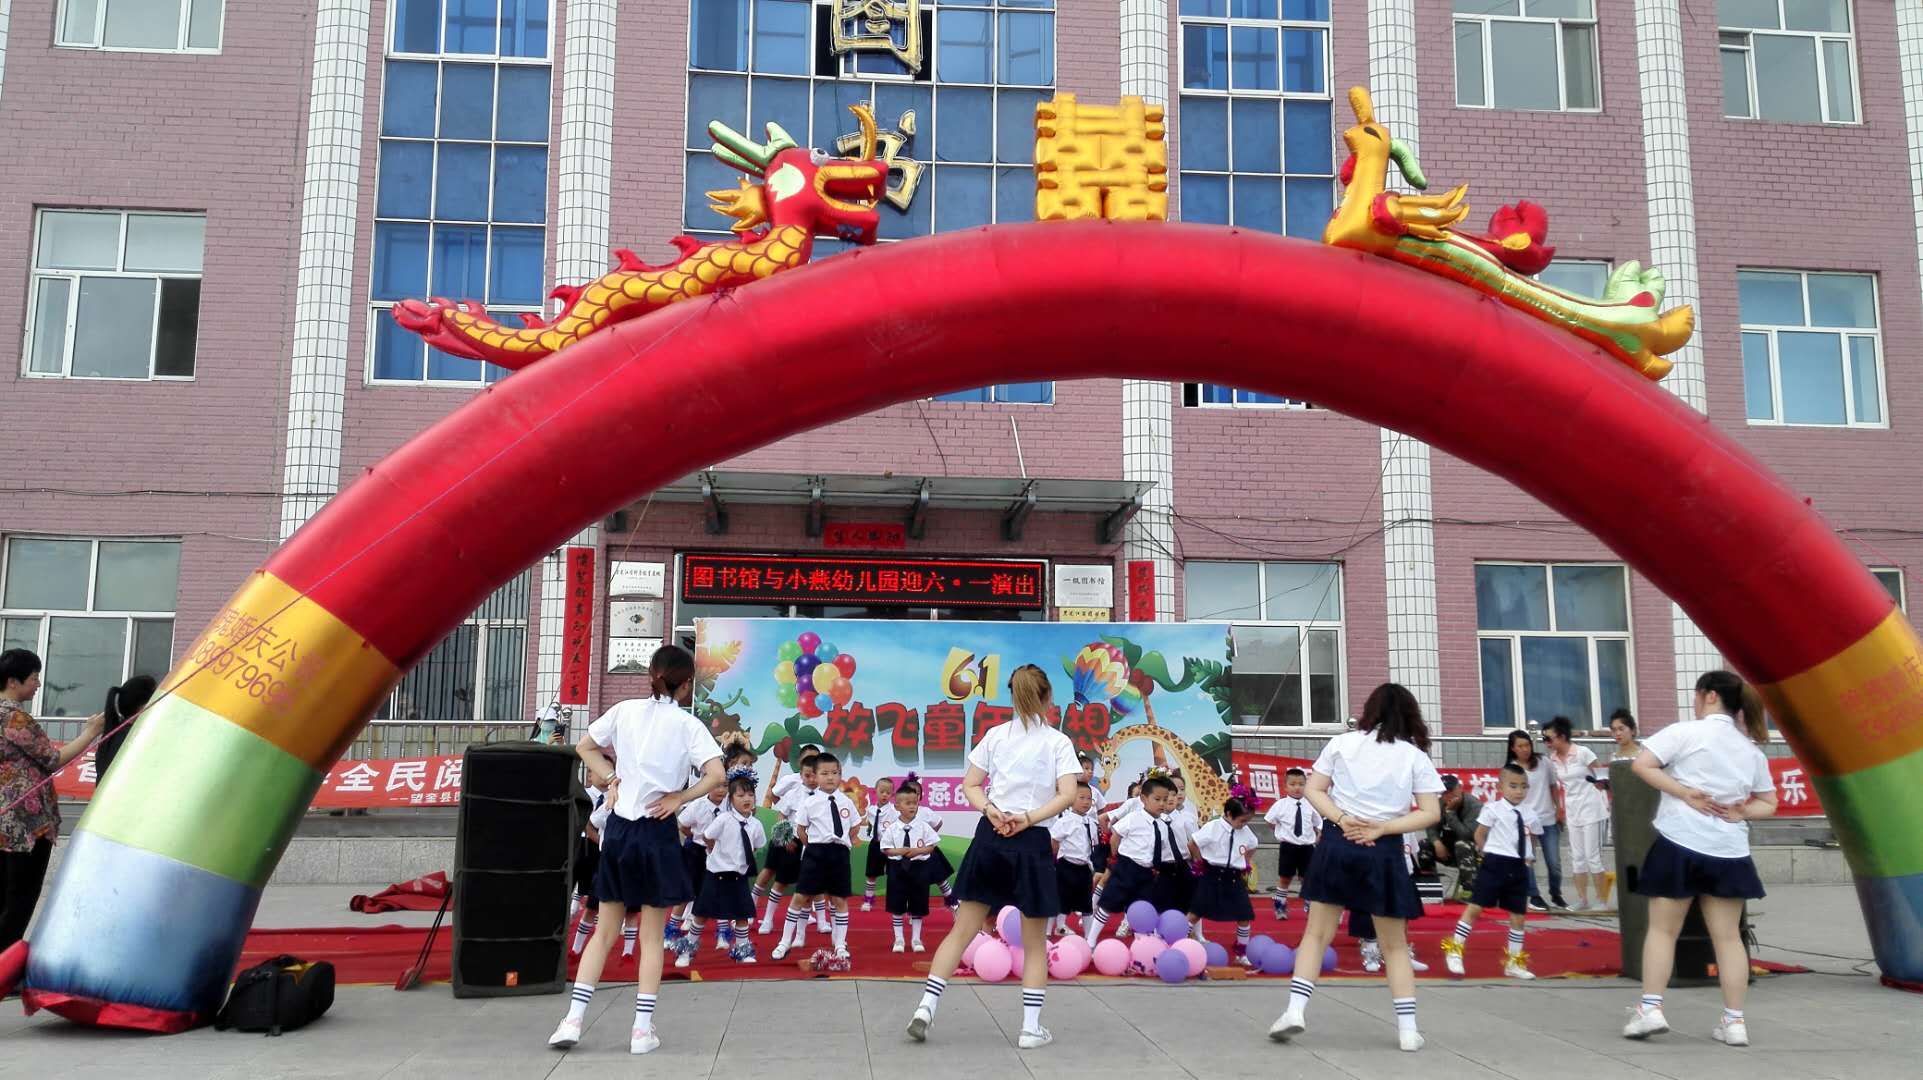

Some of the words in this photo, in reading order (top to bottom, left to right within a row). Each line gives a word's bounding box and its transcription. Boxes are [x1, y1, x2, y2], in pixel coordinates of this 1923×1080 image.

[322, 759, 463, 792] 全民阅
[1781, 768, 1808, 806] 乐
